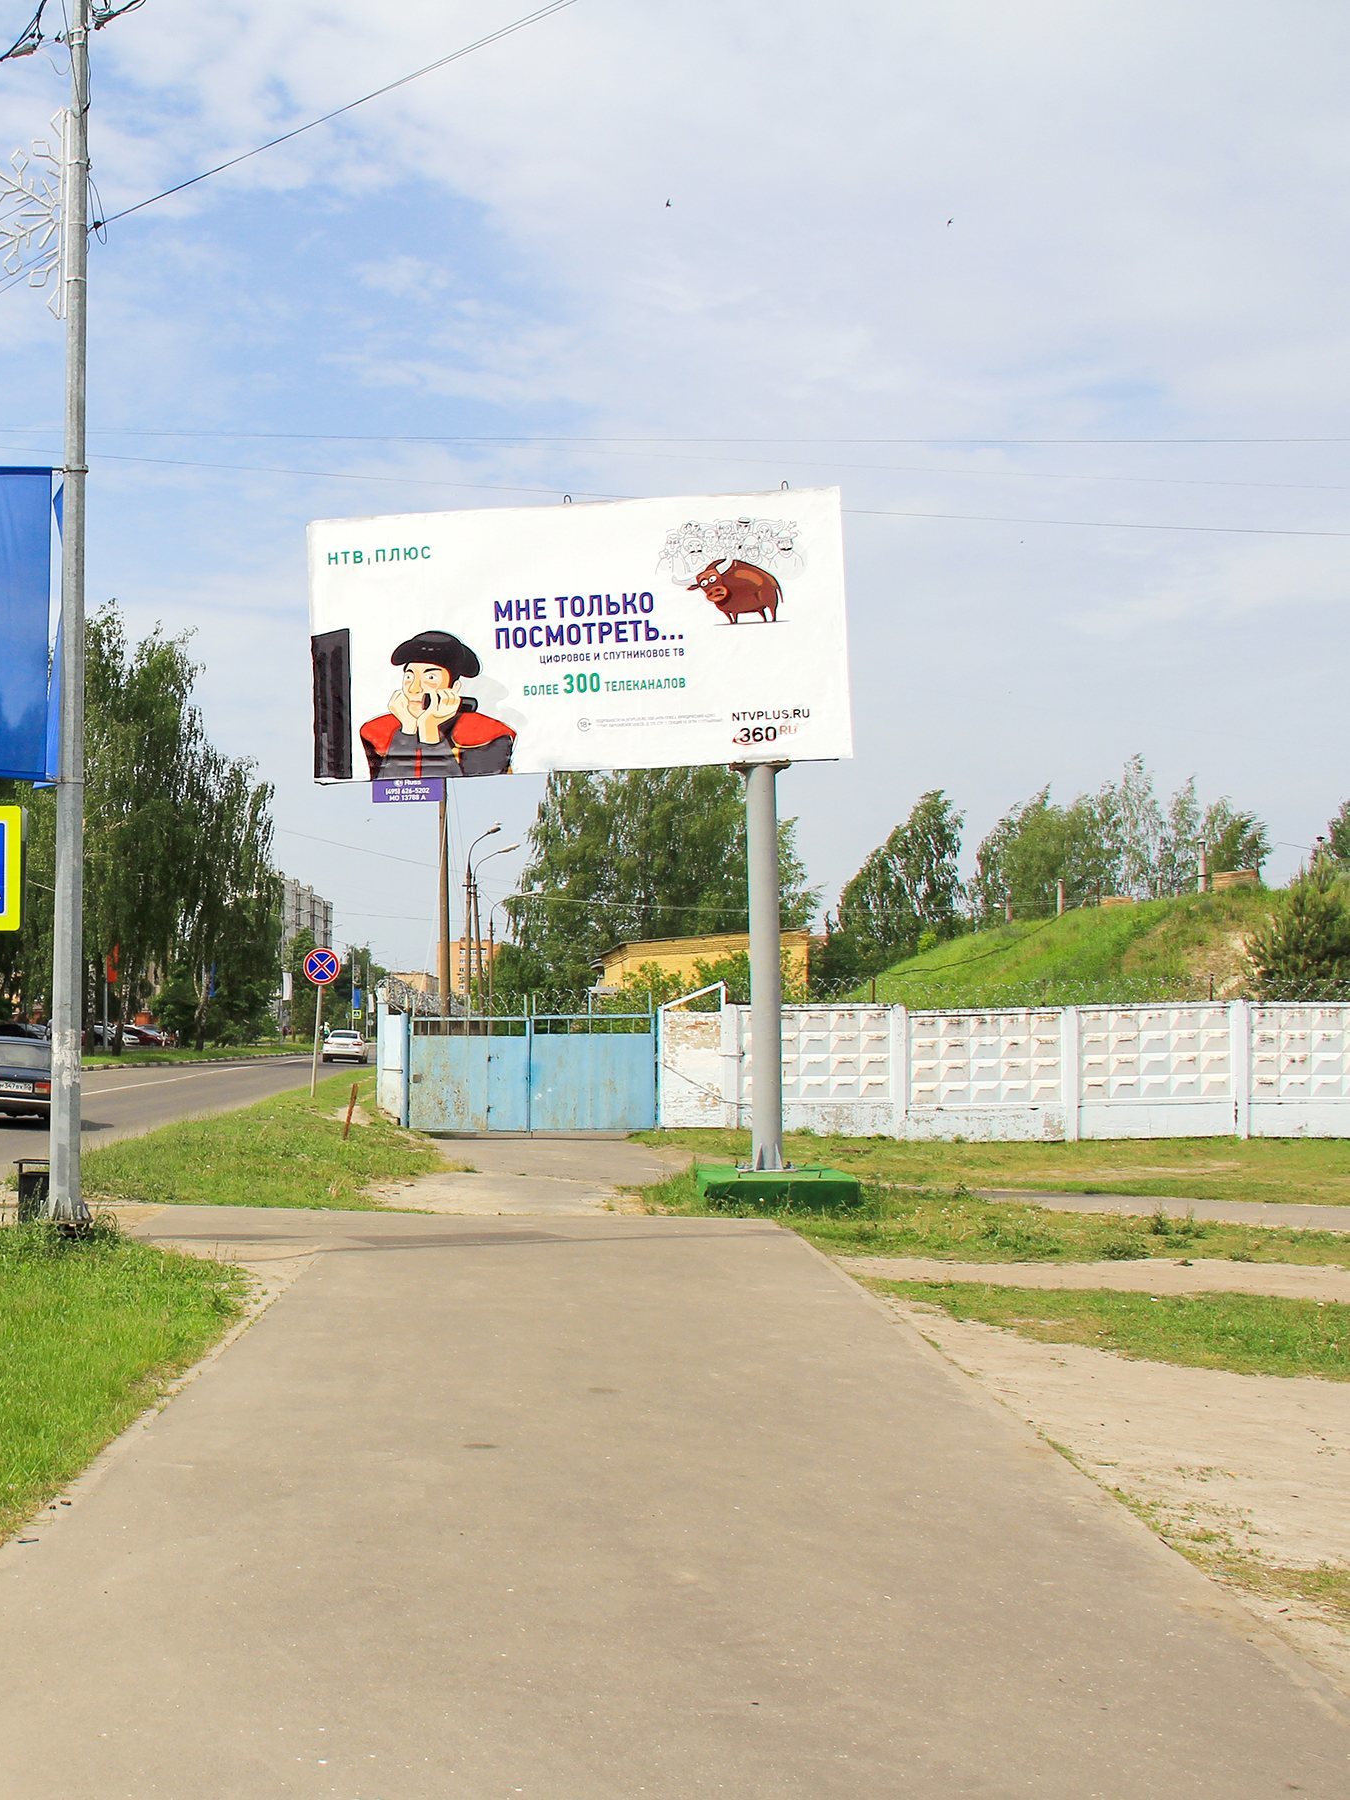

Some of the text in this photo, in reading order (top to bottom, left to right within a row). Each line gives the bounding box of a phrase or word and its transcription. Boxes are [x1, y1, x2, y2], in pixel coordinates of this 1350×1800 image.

[375, 546, 431, 562] ПЛЮС
[494, 592, 654, 622] МНЕ ТОЛЬКО
[495, 620, 684, 650] ПОСМОТРЕТЬ...
[539, 648, 685, 664] ЦИФРОВОЕ И СПУТНИКОВОЕ ТВ
[523, 672, 686, 696] БОЛЕЕ 300 ТЕЛЕКАНАЛОВ
[731, 708, 811, 722] NTVPLUS.RU
